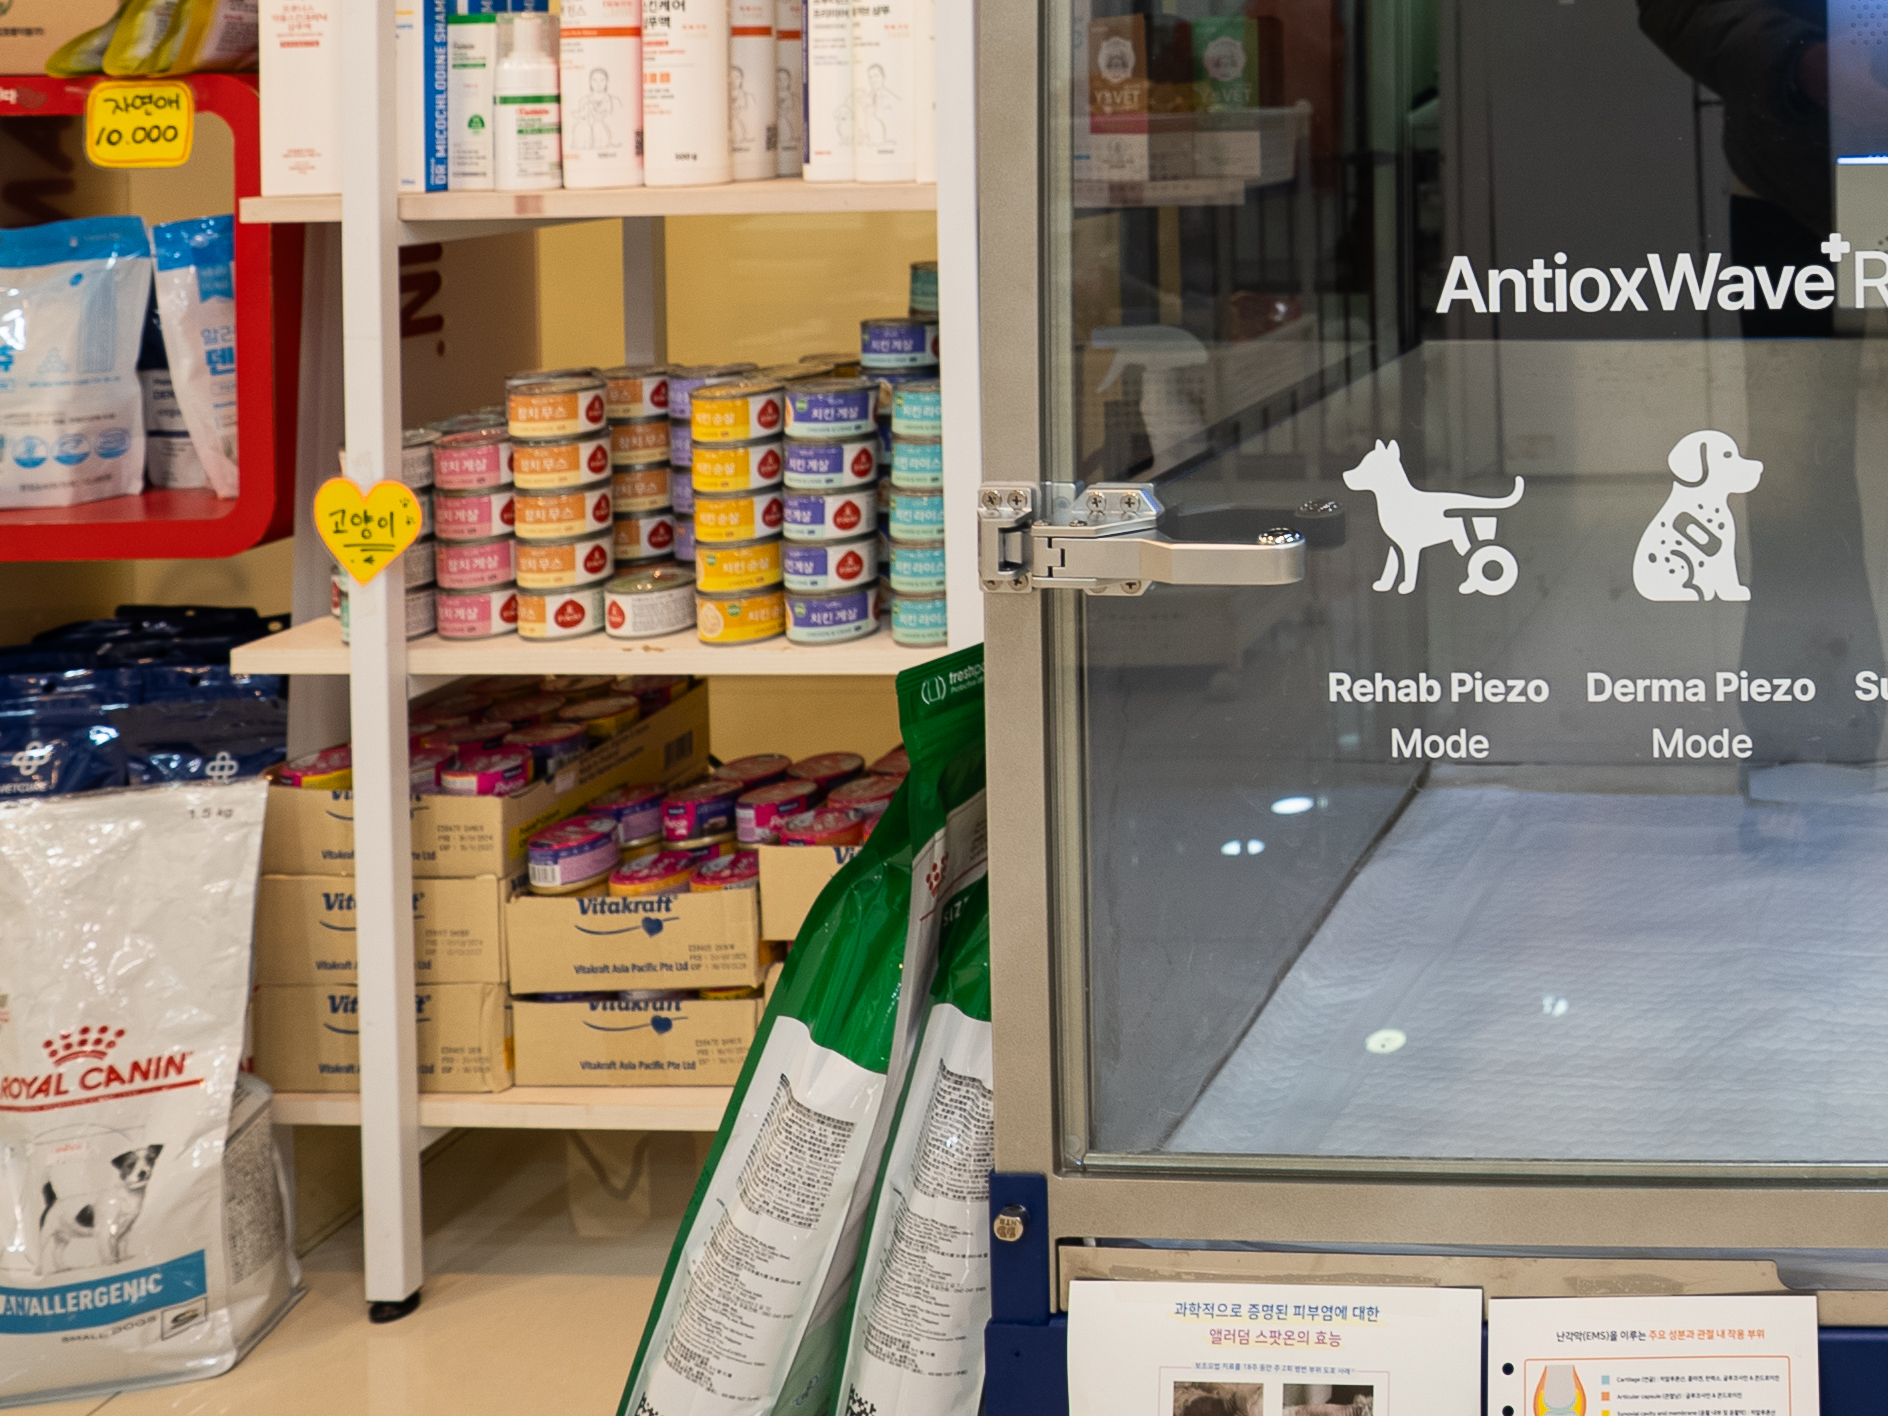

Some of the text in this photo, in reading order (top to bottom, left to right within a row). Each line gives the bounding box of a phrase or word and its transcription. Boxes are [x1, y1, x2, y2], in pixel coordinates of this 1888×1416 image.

[1436, 251, 1836, 314] AntioxWave
[329, 508, 394, 540] 고양이
[1328, 672, 1549, 702] Rehab Piezo
[1587, 671, 1816, 702] Derma Piezo
[1391, 727, 1490, 758] Mode
[1653, 727, 1753, 758] Mode
[577, 895, 673, 915] Vitakraft
[574, 962, 688, 974] Vitakraft Asia Pacific Pte Ltd
[79, 1051, 187, 1091] CANIN
[1174, 1302, 1380, 1322] 과학적으로 증명된 피부염에 대한
[1209, 1328, 1342, 1348] 앨러덤 스팟온의 효능
[1621, 1331, 1646, 1342] 이루는
[1649, 1329, 1666, 1341] 주요
[1669, 1329, 1694, 1341] 성분과
[1697, 1329, 1714, 1341] 관절
[1717, 1329, 1726, 1340] 내
[1728, 1329, 1745, 1341] 작용
[1747, 1329, 1765, 1341] 부위
